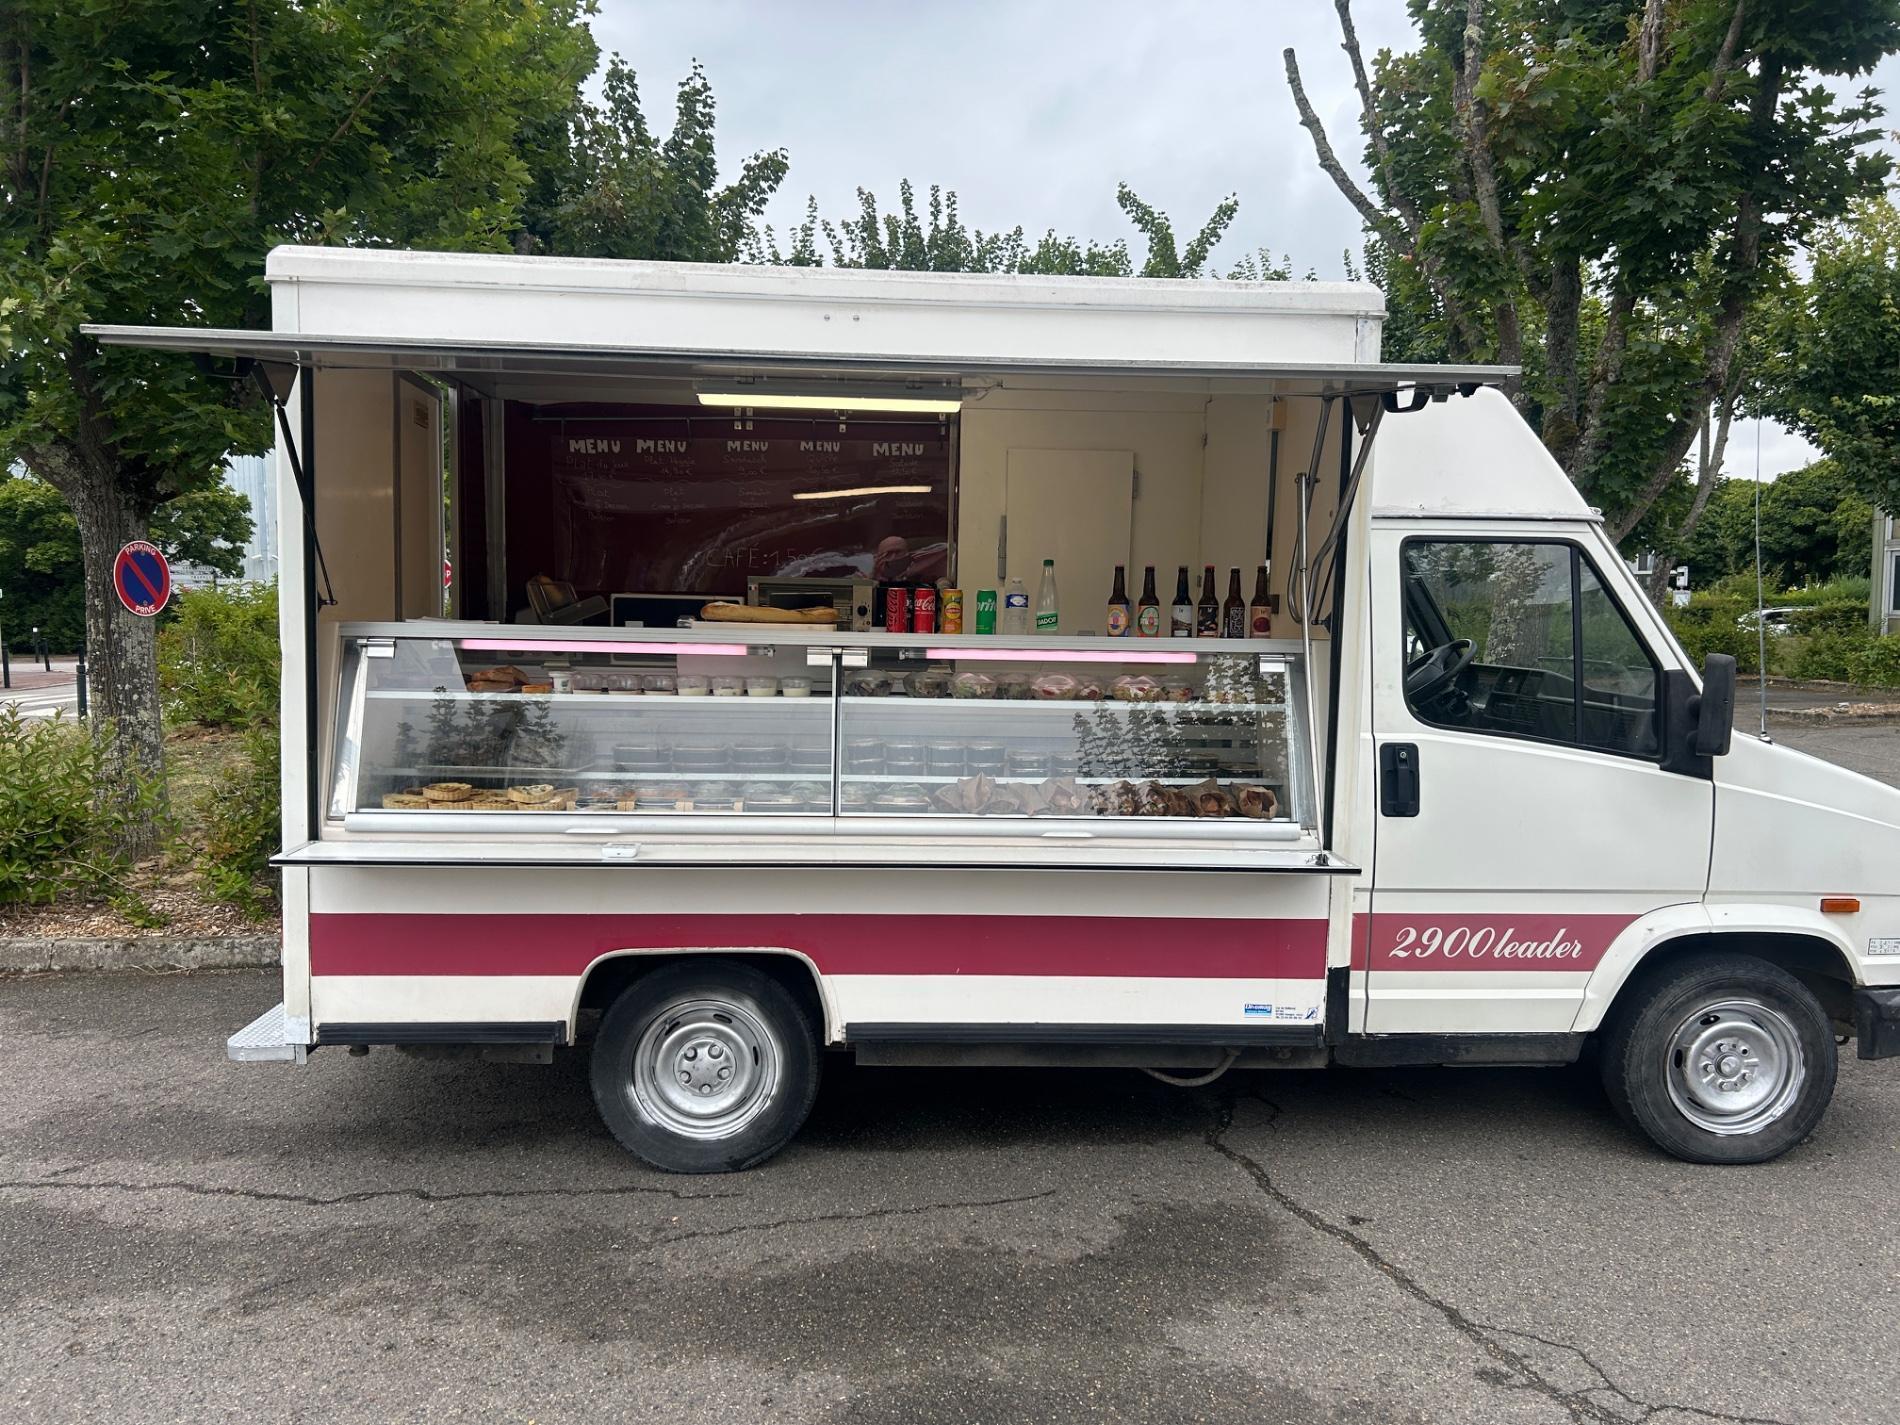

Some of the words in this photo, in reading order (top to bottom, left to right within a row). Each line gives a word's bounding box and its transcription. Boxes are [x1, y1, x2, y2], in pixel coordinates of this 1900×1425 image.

[569, 439, 621, 454] MENU
[636, 439, 687, 454] MENU
[727, 440, 769, 453] MENU
[799, 440, 841, 453] MENU
[872, 442, 925, 457] MENU
[125, 543, 156, 556] PARKING
